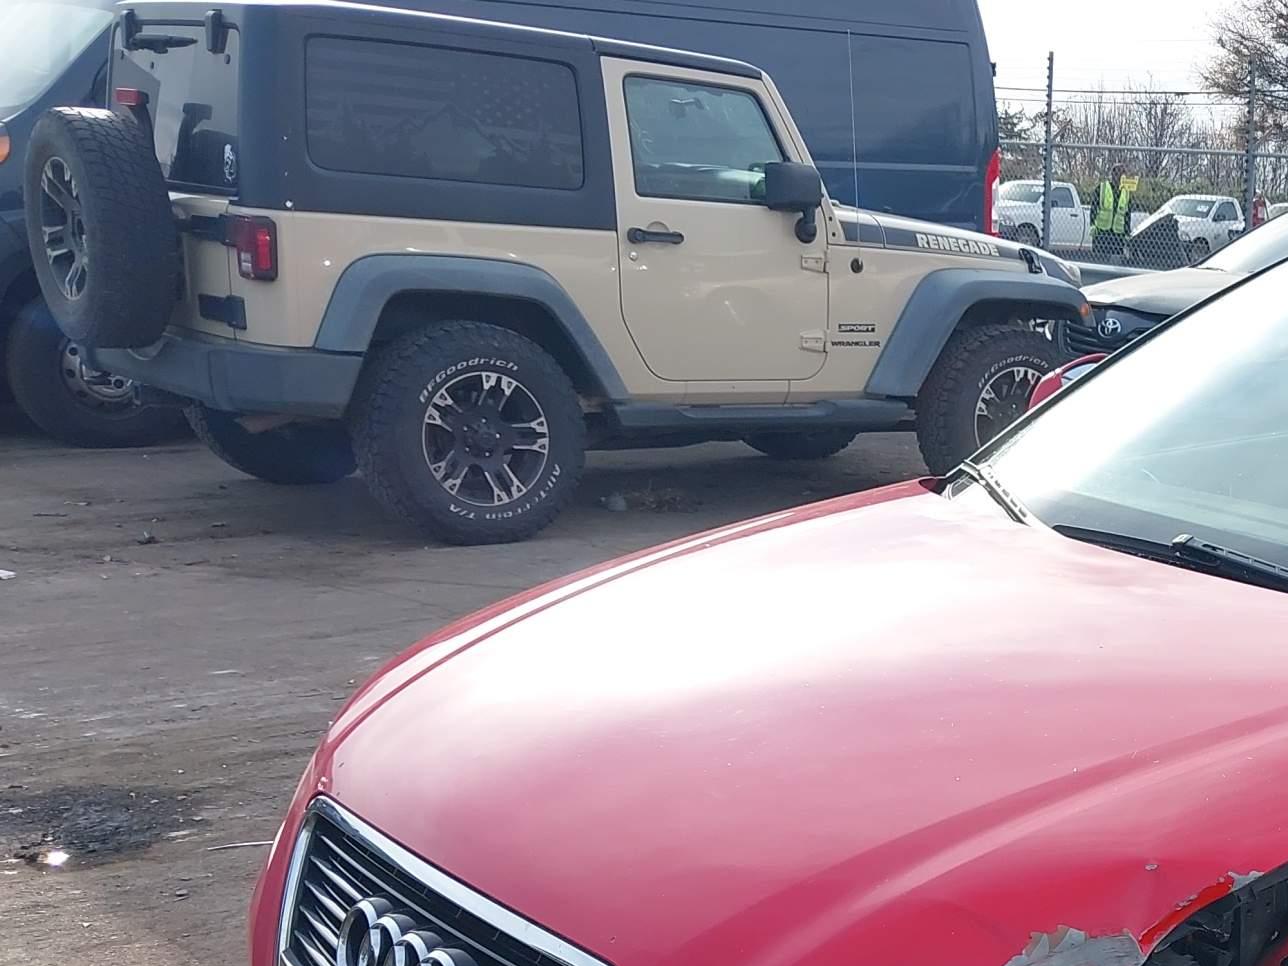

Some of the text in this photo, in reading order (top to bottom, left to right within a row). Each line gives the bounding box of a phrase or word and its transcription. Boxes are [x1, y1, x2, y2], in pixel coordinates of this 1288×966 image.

[915, 233, 999, 256] RENEGADE
[839, 324, 875, 332] SPORT
[831, 340, 881, 348] WRANGLER
[418, 357, 519, 404] BFGoodrich
